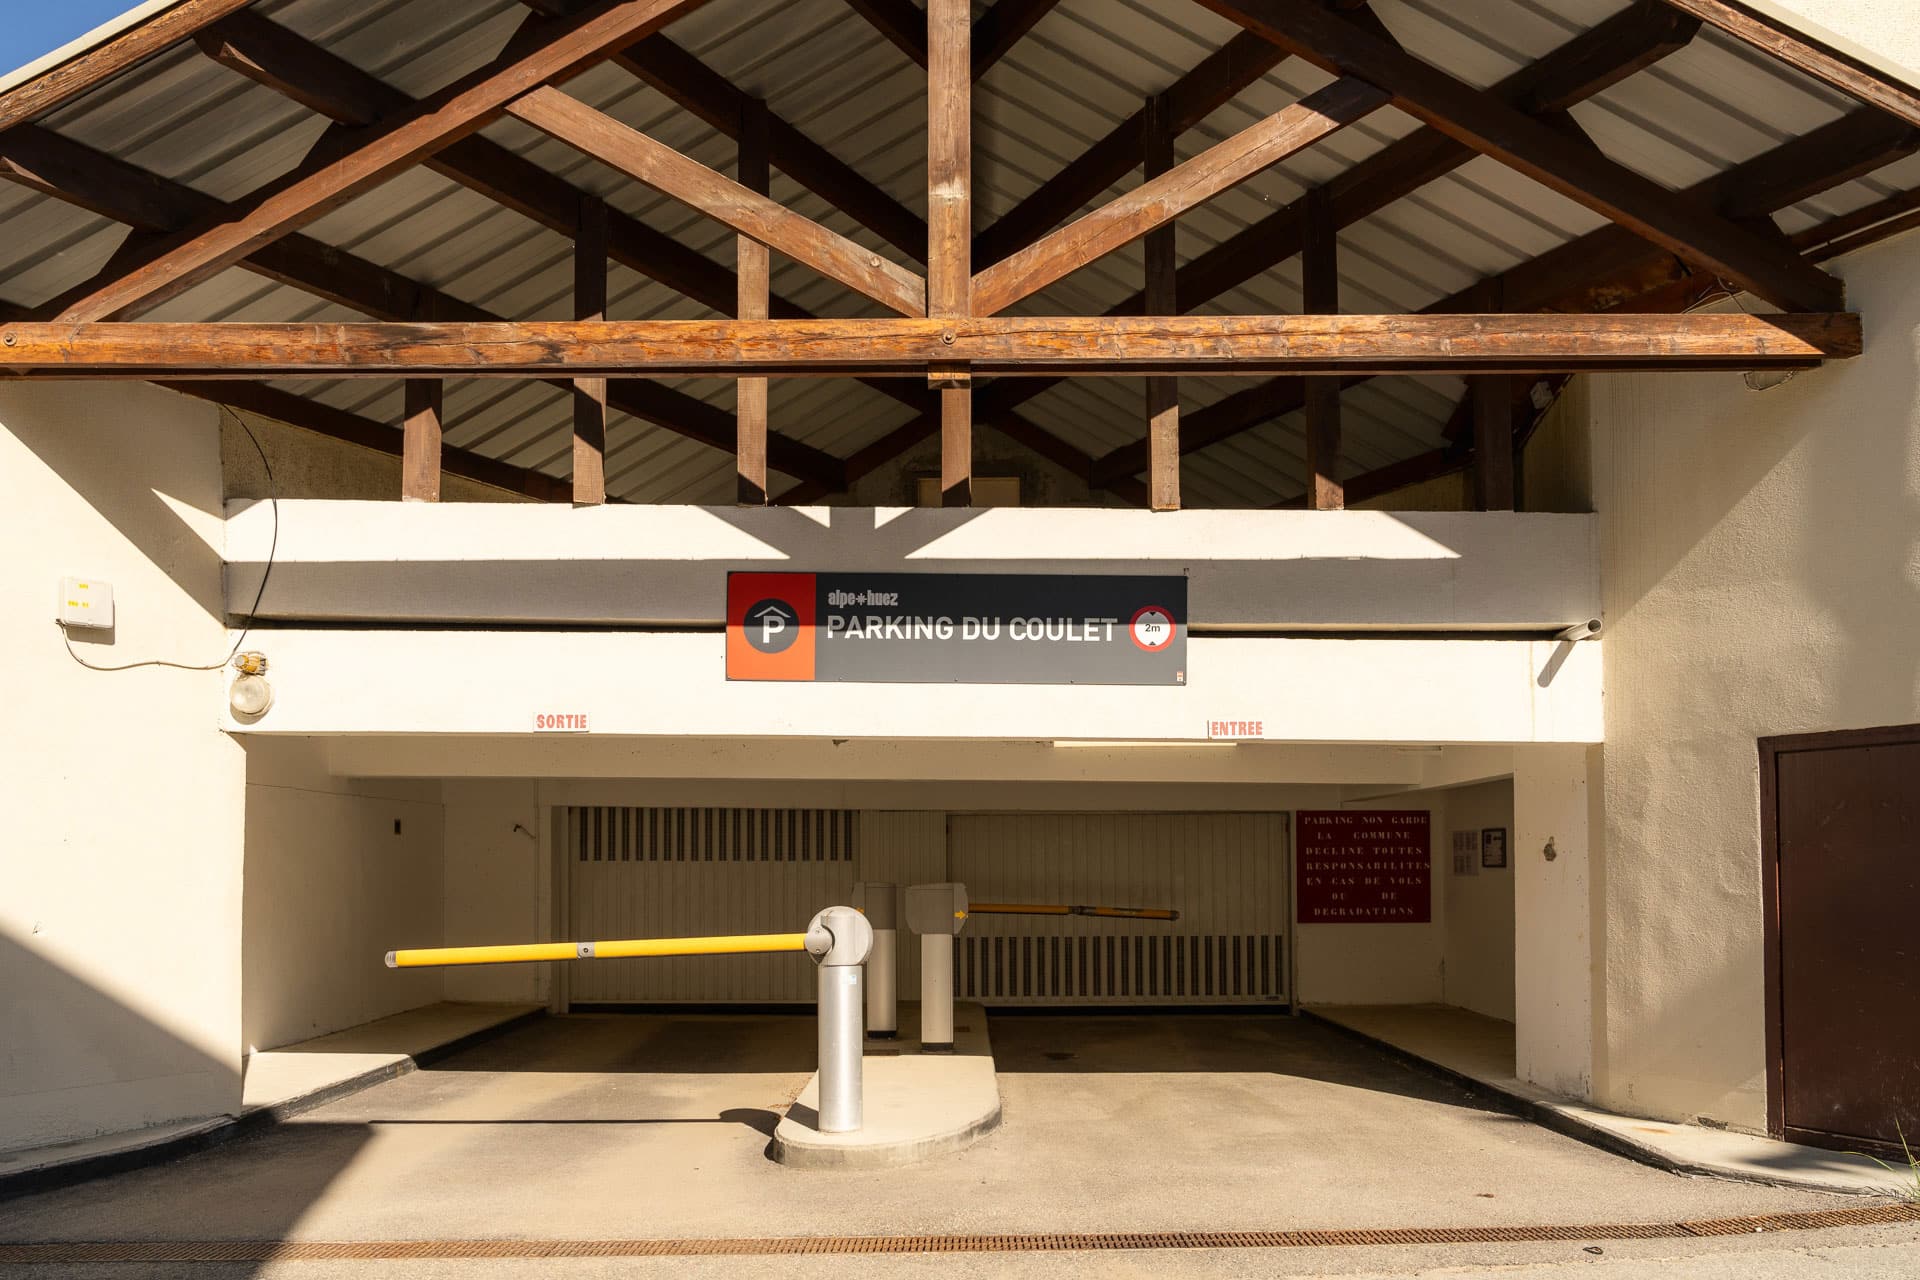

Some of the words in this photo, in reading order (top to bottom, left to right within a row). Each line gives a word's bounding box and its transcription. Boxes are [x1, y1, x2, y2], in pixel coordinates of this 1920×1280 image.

[828, 590, 855, 608] alpe
[867, 590, 899, 606] huez
[763, 616, 785, 644] P
[827, 615, 954, 640] PARKING
[962, 616, 1000, 640] DU
[1009, 617, 1118, 642] COULET
[1145, 623, 1161, 632] 2m
[536, 714, 587, 728] SORTIE
[1211, 721, 1263, 736] ENTREE
[1304, 816, 1353, 825] PARKING
[1361, 816, 1384, 825] NON
[1391, 816, 1428, 825] GARDE
[1317, 831, 1333, 840] LA
[1353, 831, 1410, 840] COMMUNE
[1305, 847, 1362, 856] DECLINE
[1374, 847, 1422, 855] TOUTES
[1306, 861, 1431, 871] RESPONSABILITES
[1306, 877, 1322, 886] EN
[1331, 877, 1355, 886] CAS
[1364, 877, 1381, 886] DE
[1390, 876, 1422, 885] VOLS
[1331, 891, 1346, 900] OU
[1381, 891, 1398, 900] DE
[1313, 907, 1414, 917] DEGRADATIONS
